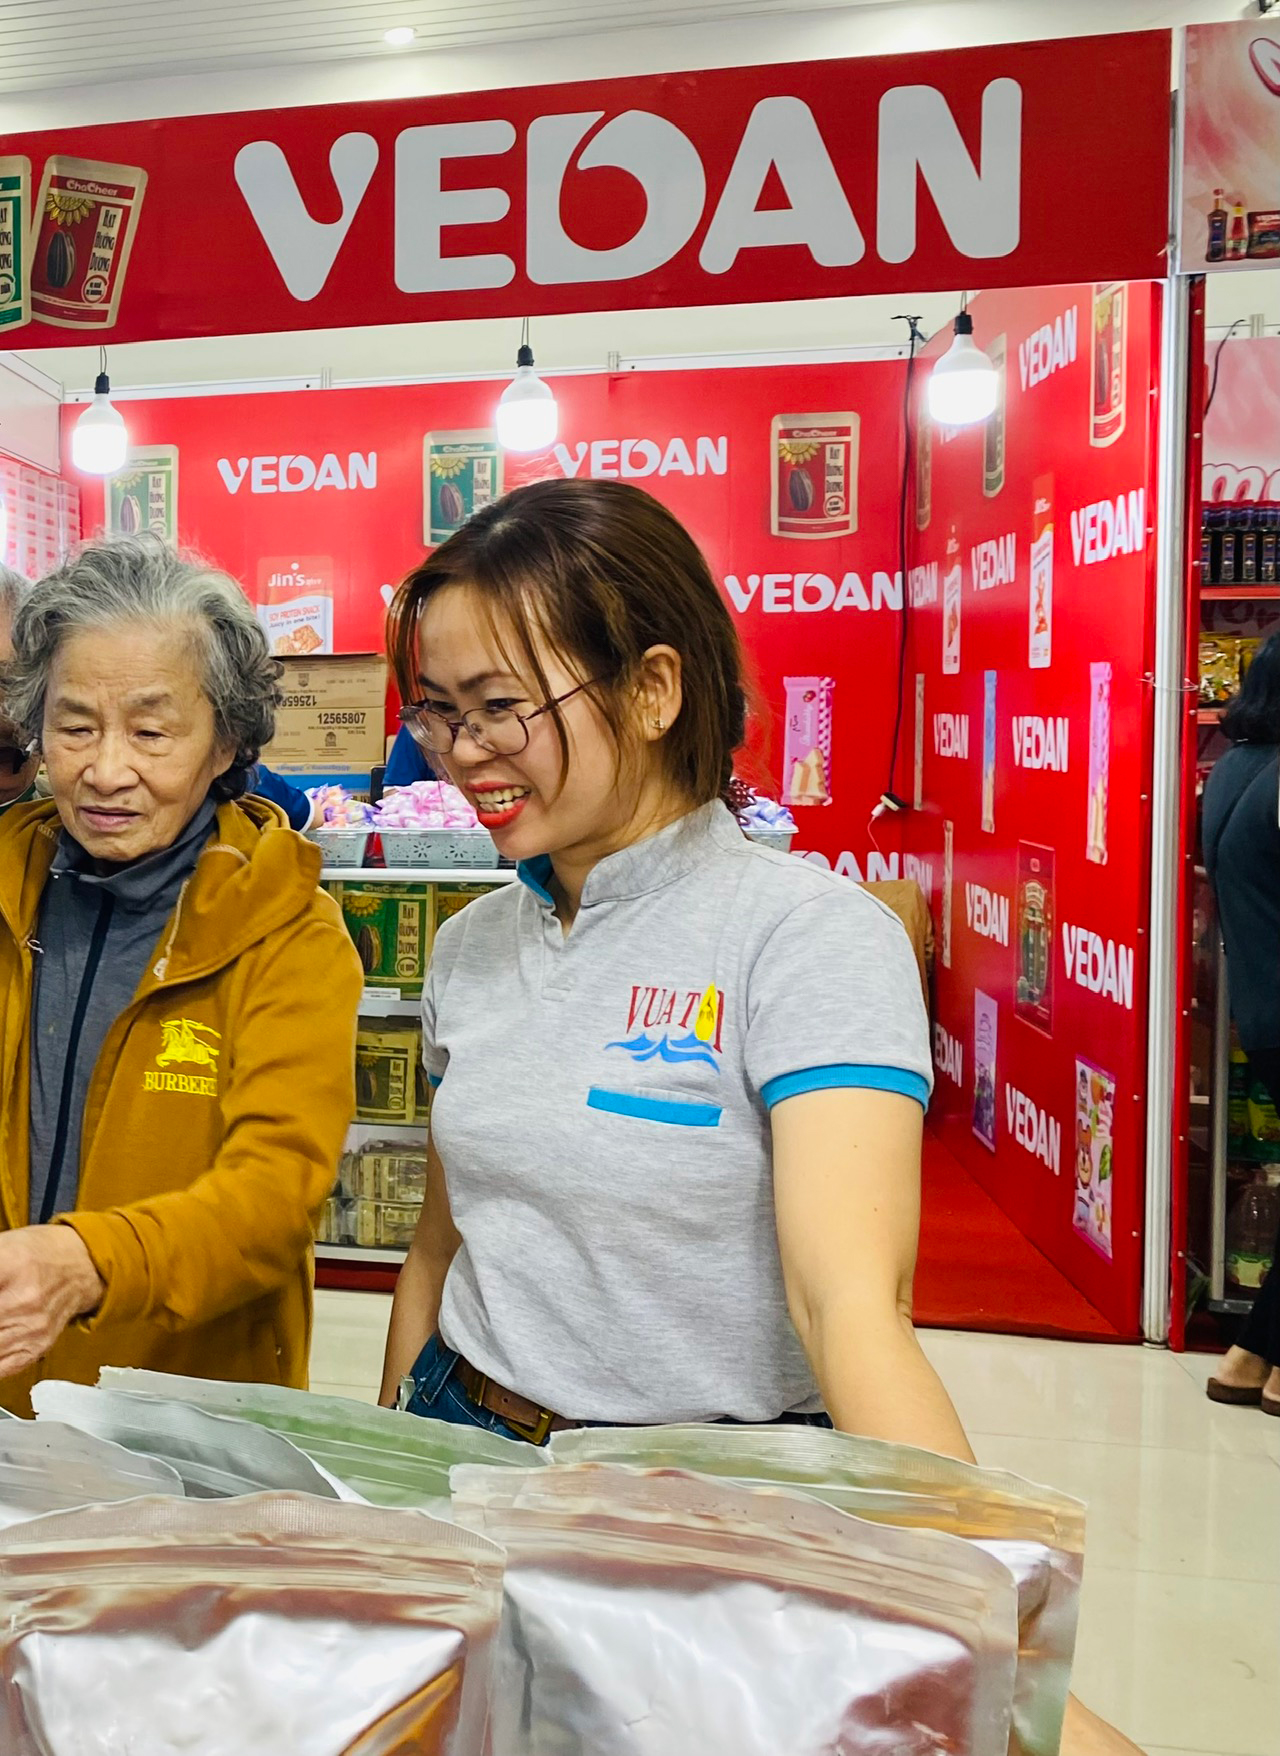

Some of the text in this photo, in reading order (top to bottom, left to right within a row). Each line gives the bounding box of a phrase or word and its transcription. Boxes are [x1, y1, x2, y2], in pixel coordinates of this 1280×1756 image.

[66, 179, 118, 196] ChaCheer
[234, 77, 1023, 302] VEDAN
[1019, 304, 1077, 392] VEDAN
[217, 452, 377, 494] VEDAN
[554, 436, 727, 480] VEDAN
[1071, 488, 1144, 566] VEDAN
[971, 533, 1016, 591] VEDAN
[724, 570, 903, 613] VEDAN
[318, 712, 366, 725] 12565807
[934, 713, 969, 760] VEDAN
[1012, 715, 1069, 773] VEDAN
[965, 881, 1009, 947] VEDAN
[1062, 922, 1133, 1010] VEDAN
[626, 985, 676, 1034] VUA
[933, 1019, 963, 1088] EDAN
[143, 1071, 218, 1097] BURBER
[1005, 1082, 1060, 1176] VEDAN
